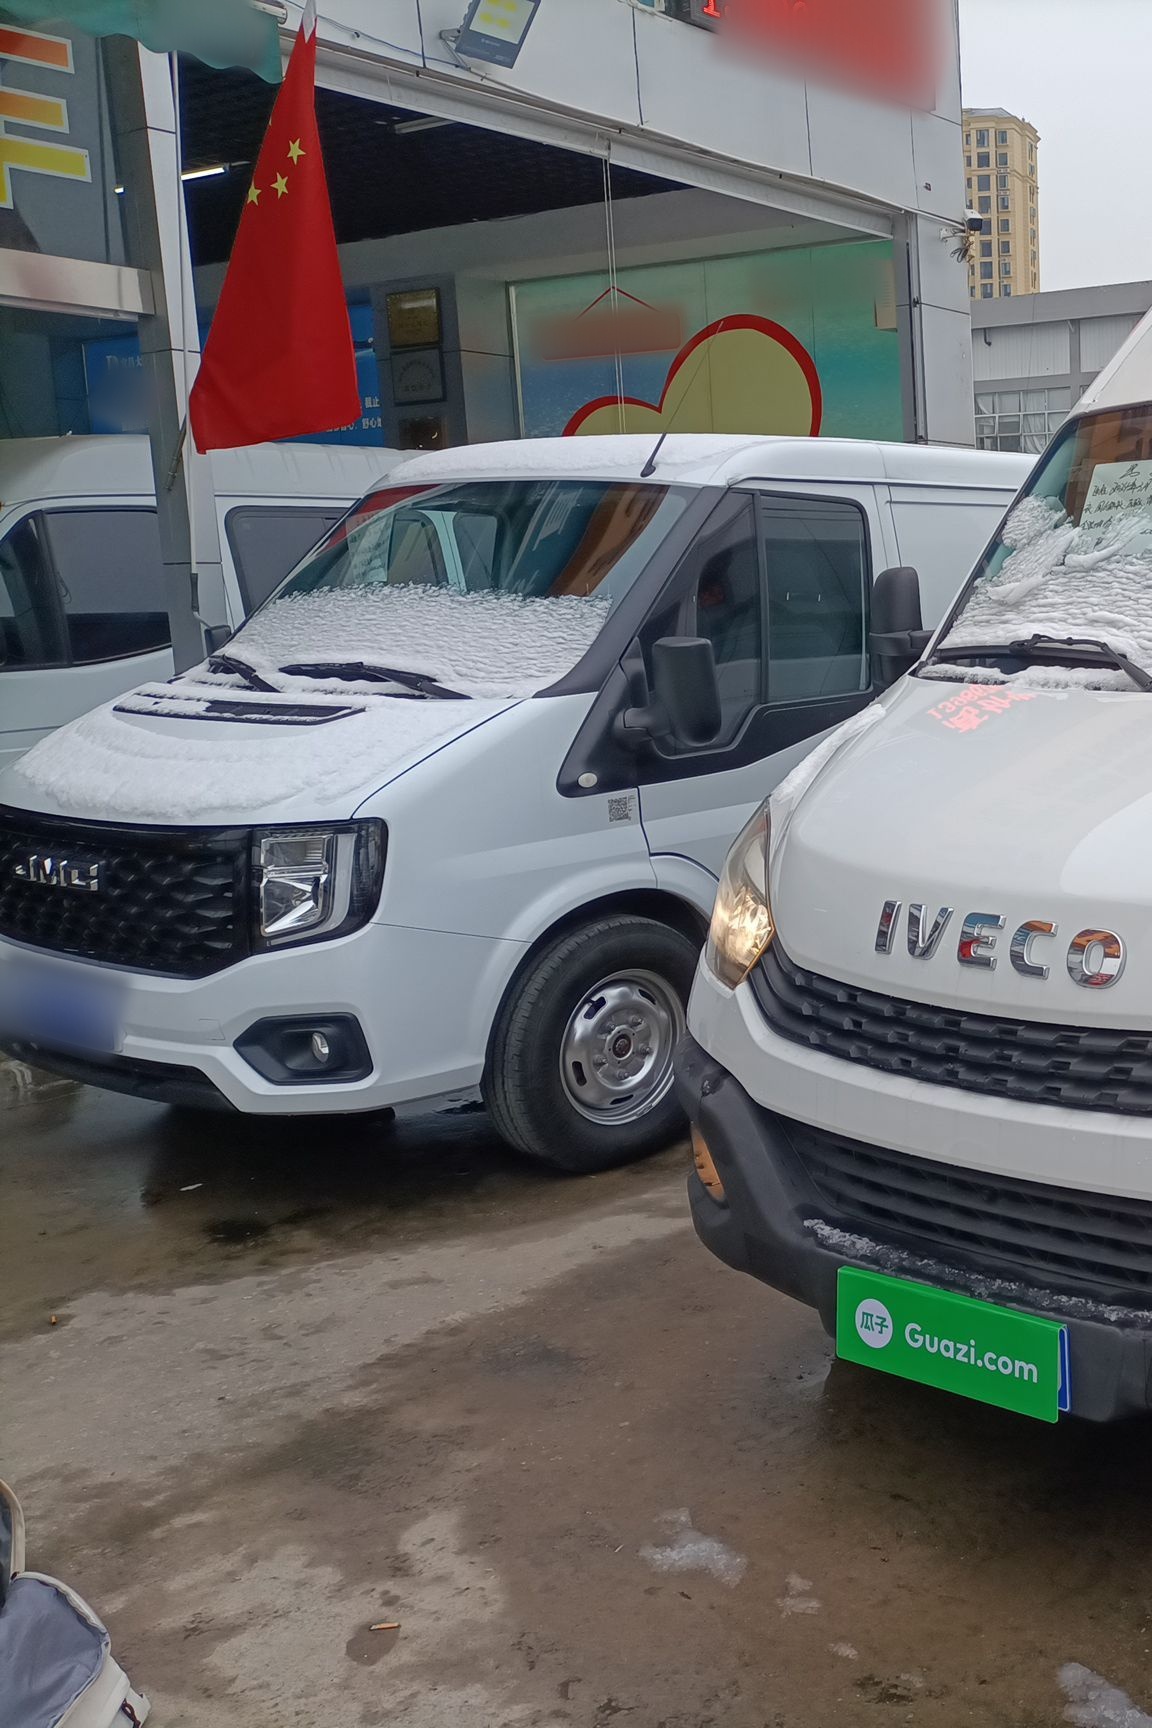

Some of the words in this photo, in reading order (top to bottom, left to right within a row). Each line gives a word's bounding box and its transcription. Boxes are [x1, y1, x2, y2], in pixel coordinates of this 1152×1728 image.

[874, 900, 1127, 990] IVECO
[859, 1310, 889, 1335] 瓜子
[904, 1322, 1039, 1384] Guazi.com
